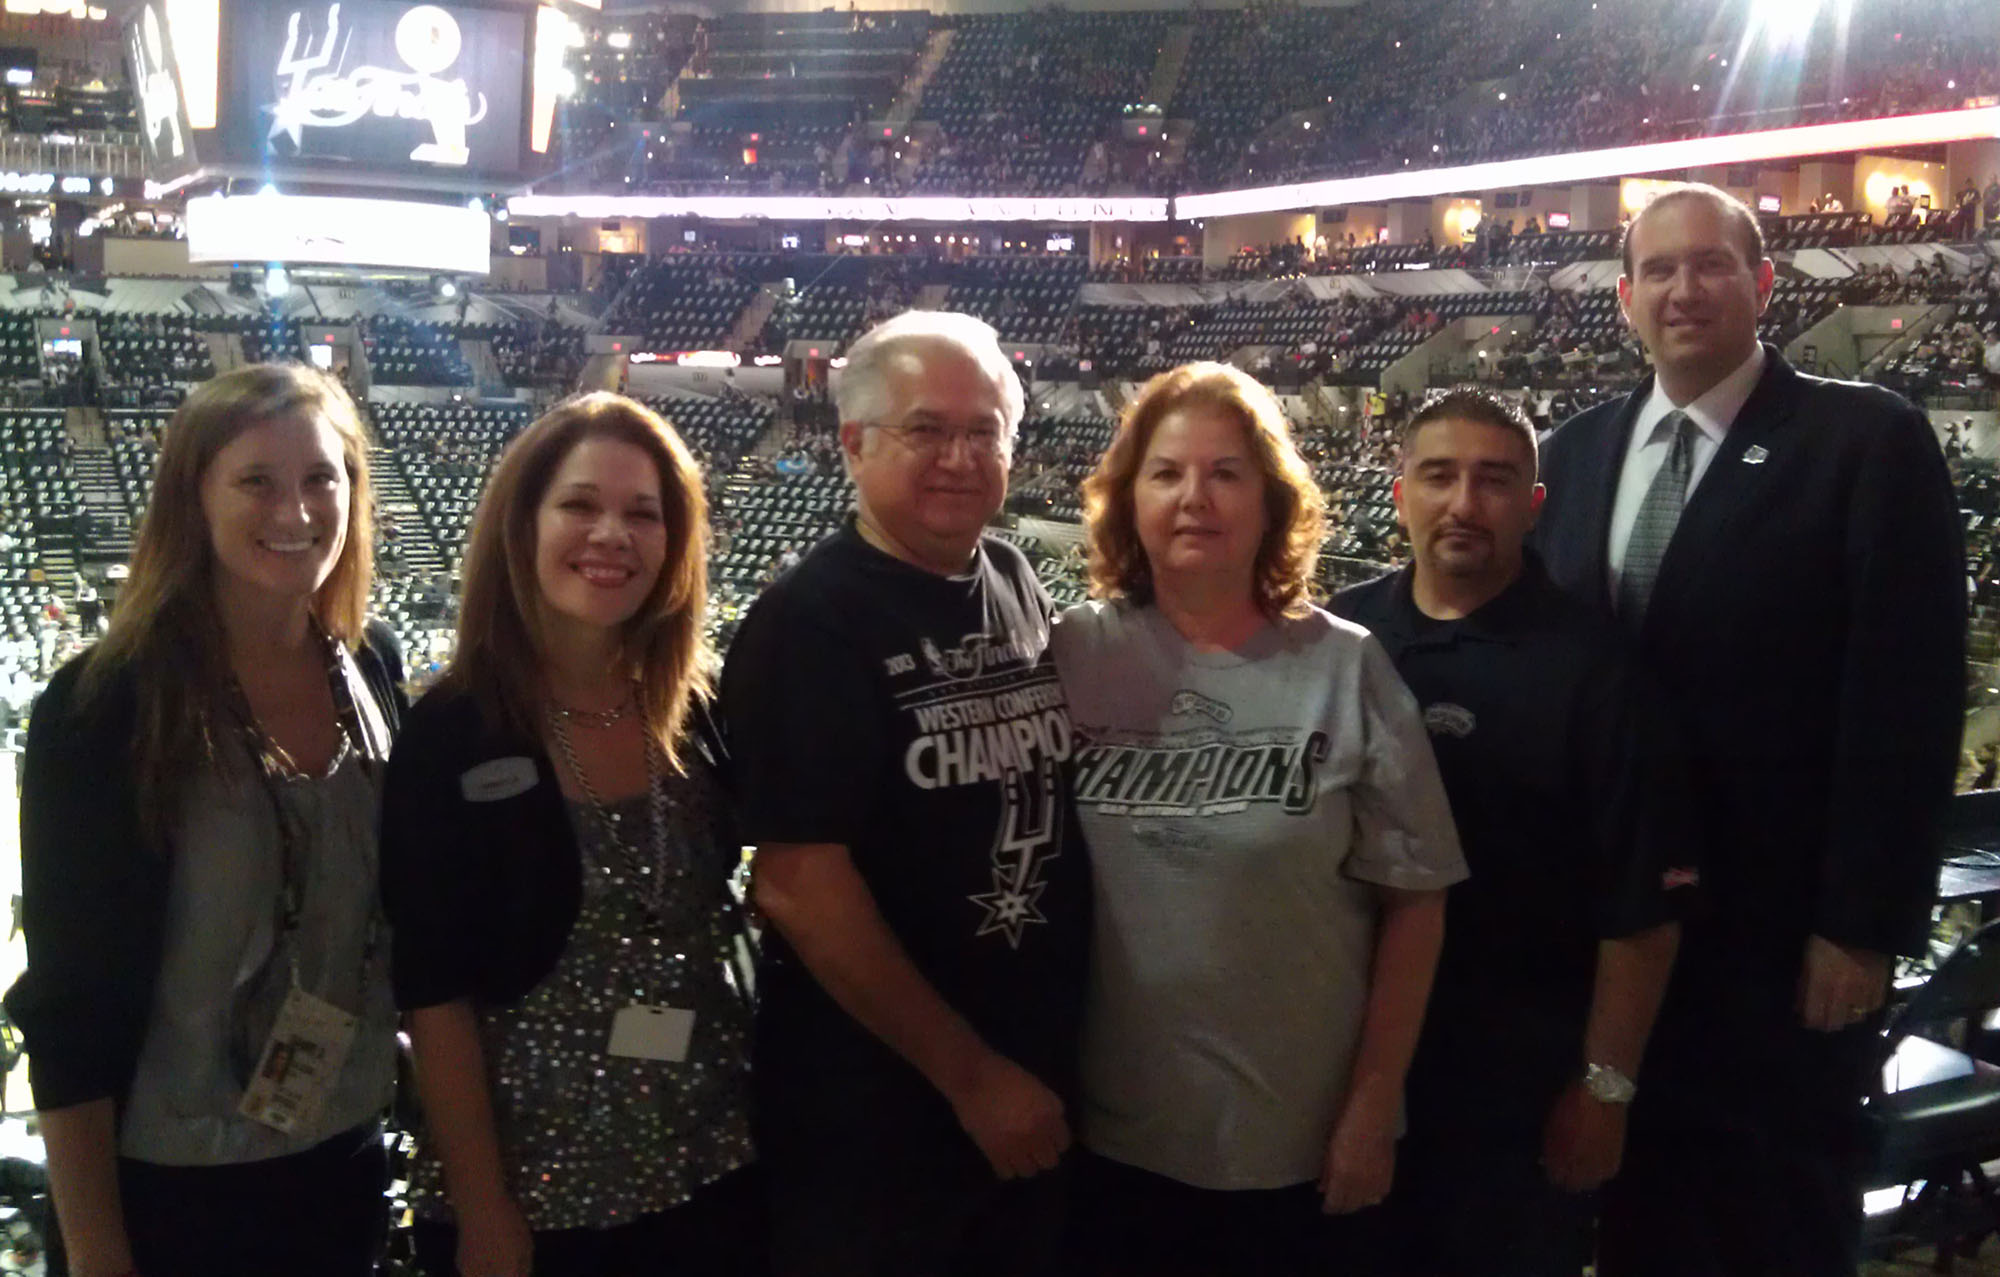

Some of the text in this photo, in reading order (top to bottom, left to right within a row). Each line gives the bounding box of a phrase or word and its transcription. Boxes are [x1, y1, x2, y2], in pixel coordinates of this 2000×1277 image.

[904, 706, 1072, 789] CHAMPIO
[914, 695, 997, 734] WESTERN
[1072, 730, 1332, 814] HAMPIONS
